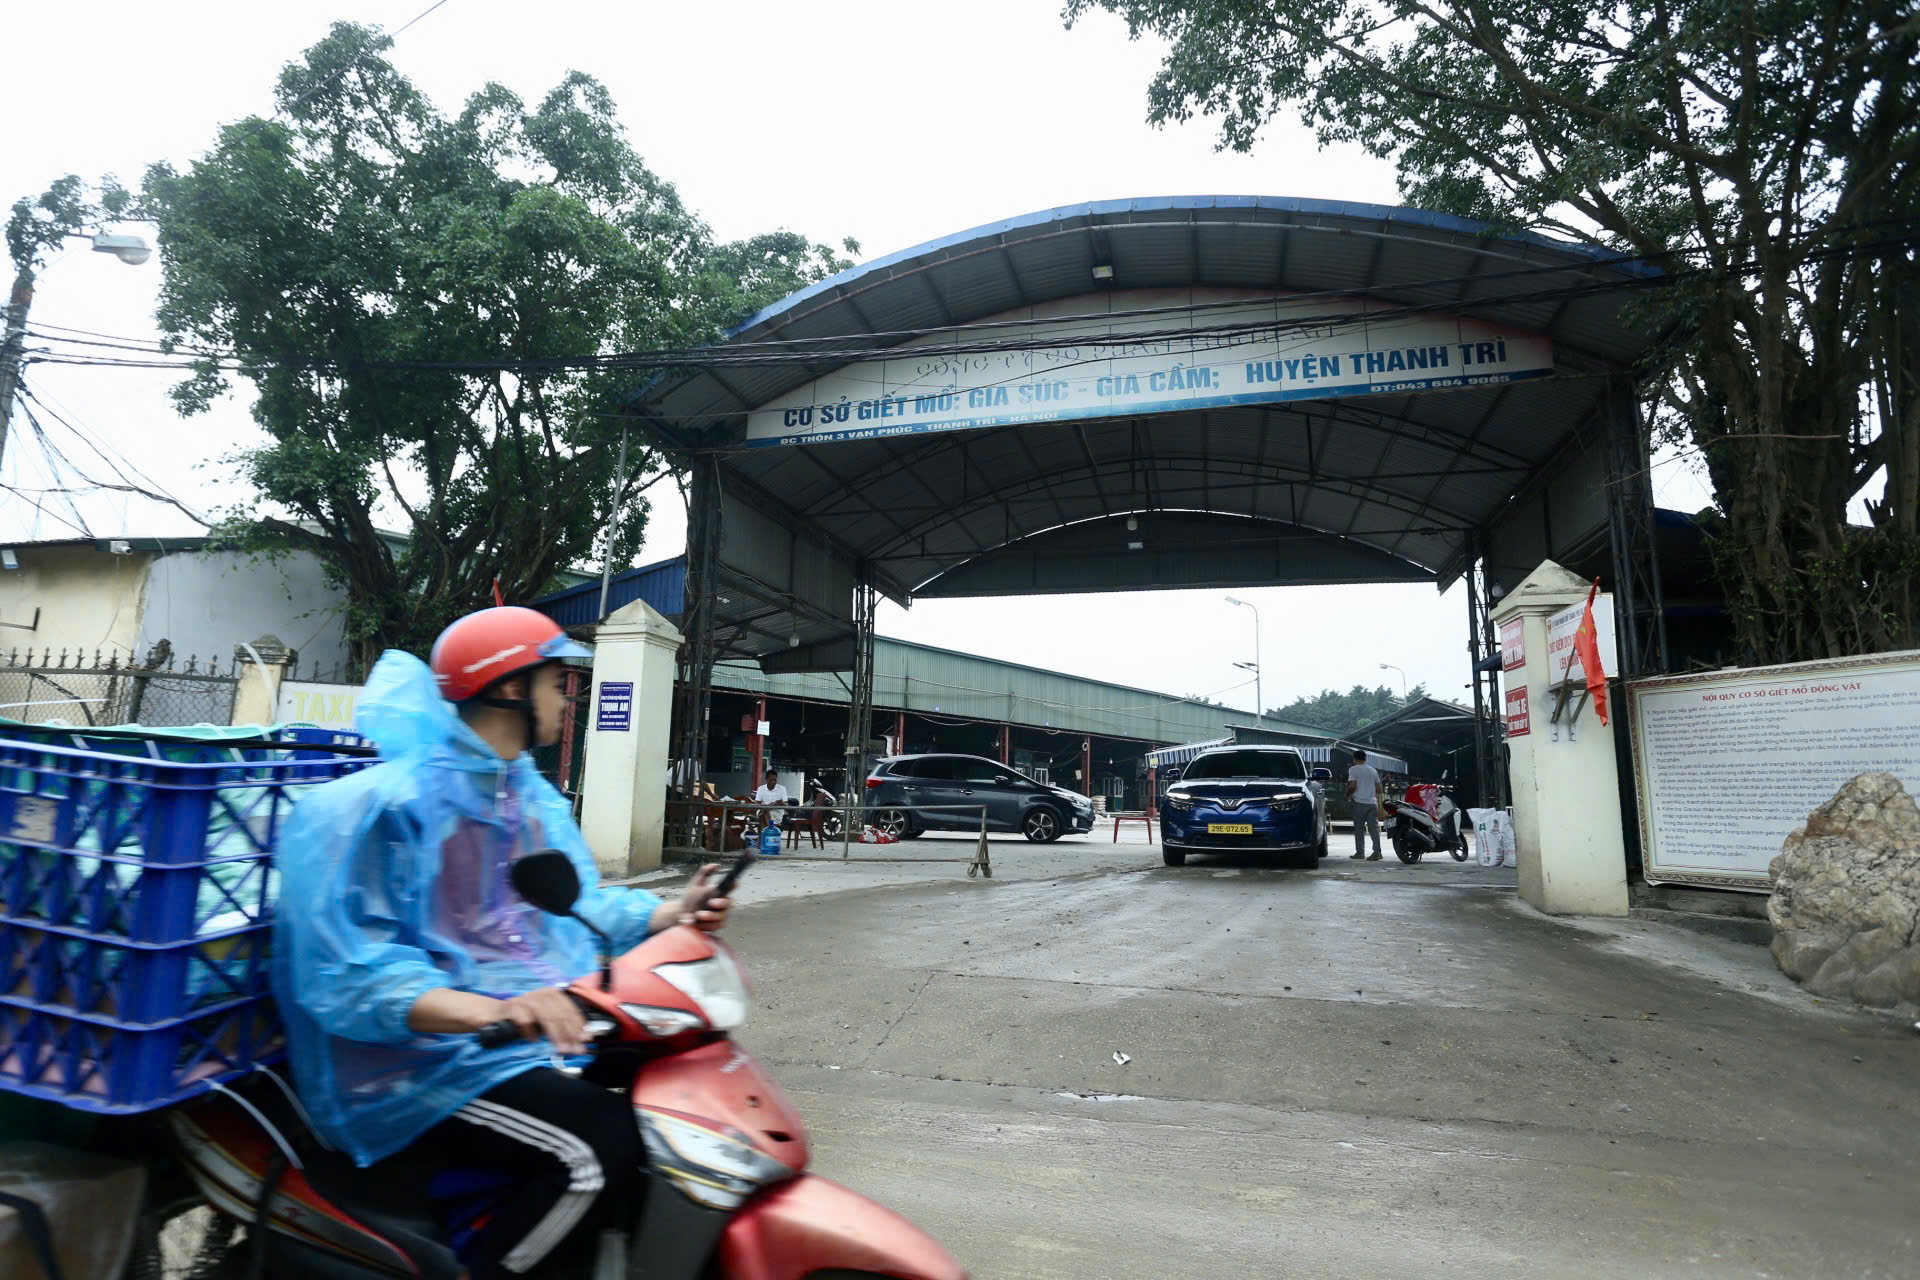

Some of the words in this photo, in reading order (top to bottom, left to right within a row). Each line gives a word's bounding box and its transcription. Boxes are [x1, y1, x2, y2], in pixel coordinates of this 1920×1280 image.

[784, 405, 814, 427] CƠ
[820, 395, 852, 424] SỞ
[858, 390, 908, 421] GIẾT
[968, 386, 1009, 408] GIA
[1018, 378, 1068, 403] SÚC
[1096, 374, 1140, 397] GIA
[1246, 353, 1340, 384] HUYỆN
[1349, 346, 1449, 375] THANH
[1458, 336, 1507, 365] TRÌ
[927, 420, 970, 431] THANH
[293, 691, 354, 723] TAXI
[1719, 692, 1737, 701] QUY
